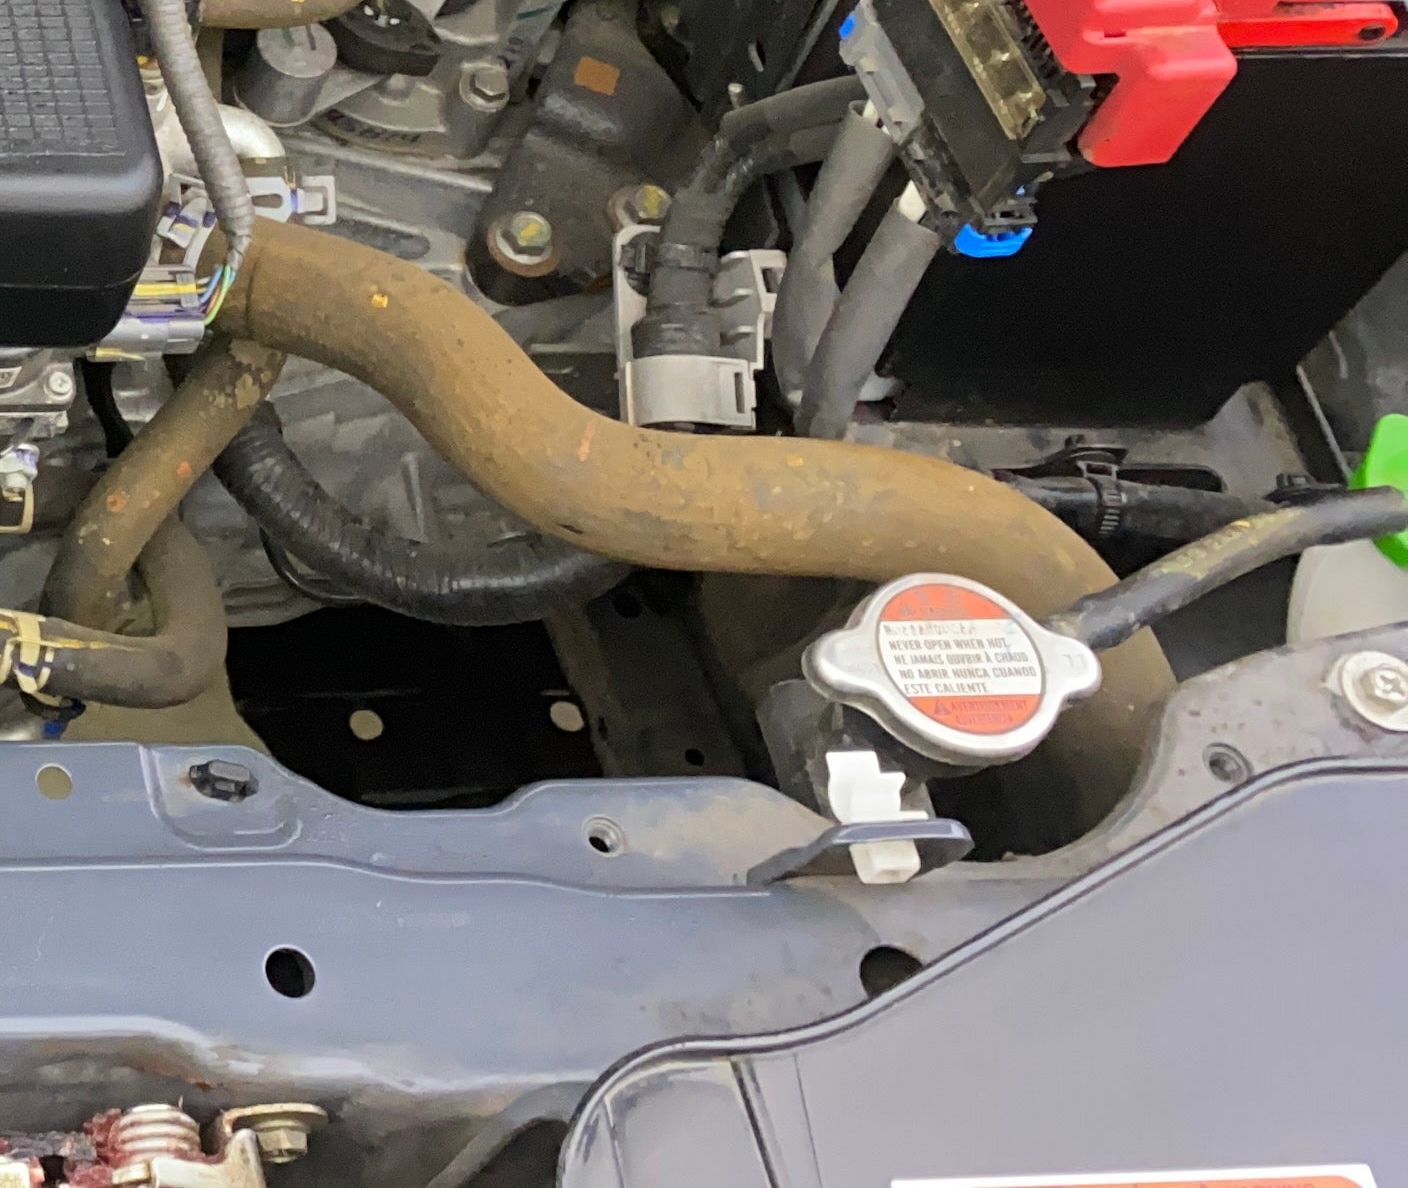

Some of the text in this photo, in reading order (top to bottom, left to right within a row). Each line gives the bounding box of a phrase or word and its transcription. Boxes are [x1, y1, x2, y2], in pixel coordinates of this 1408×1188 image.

[889, 639, 922, 650] NEVER
[924, 639, 952, 650] OPEN
[953, 638, 985, 649] WHEN
[910, 654, 944, 665] JAMAIS
[899, 666, 1037, 680] NO ABRIR NUNCA CUANDO
[904, 683, 932, 694] ESTE
